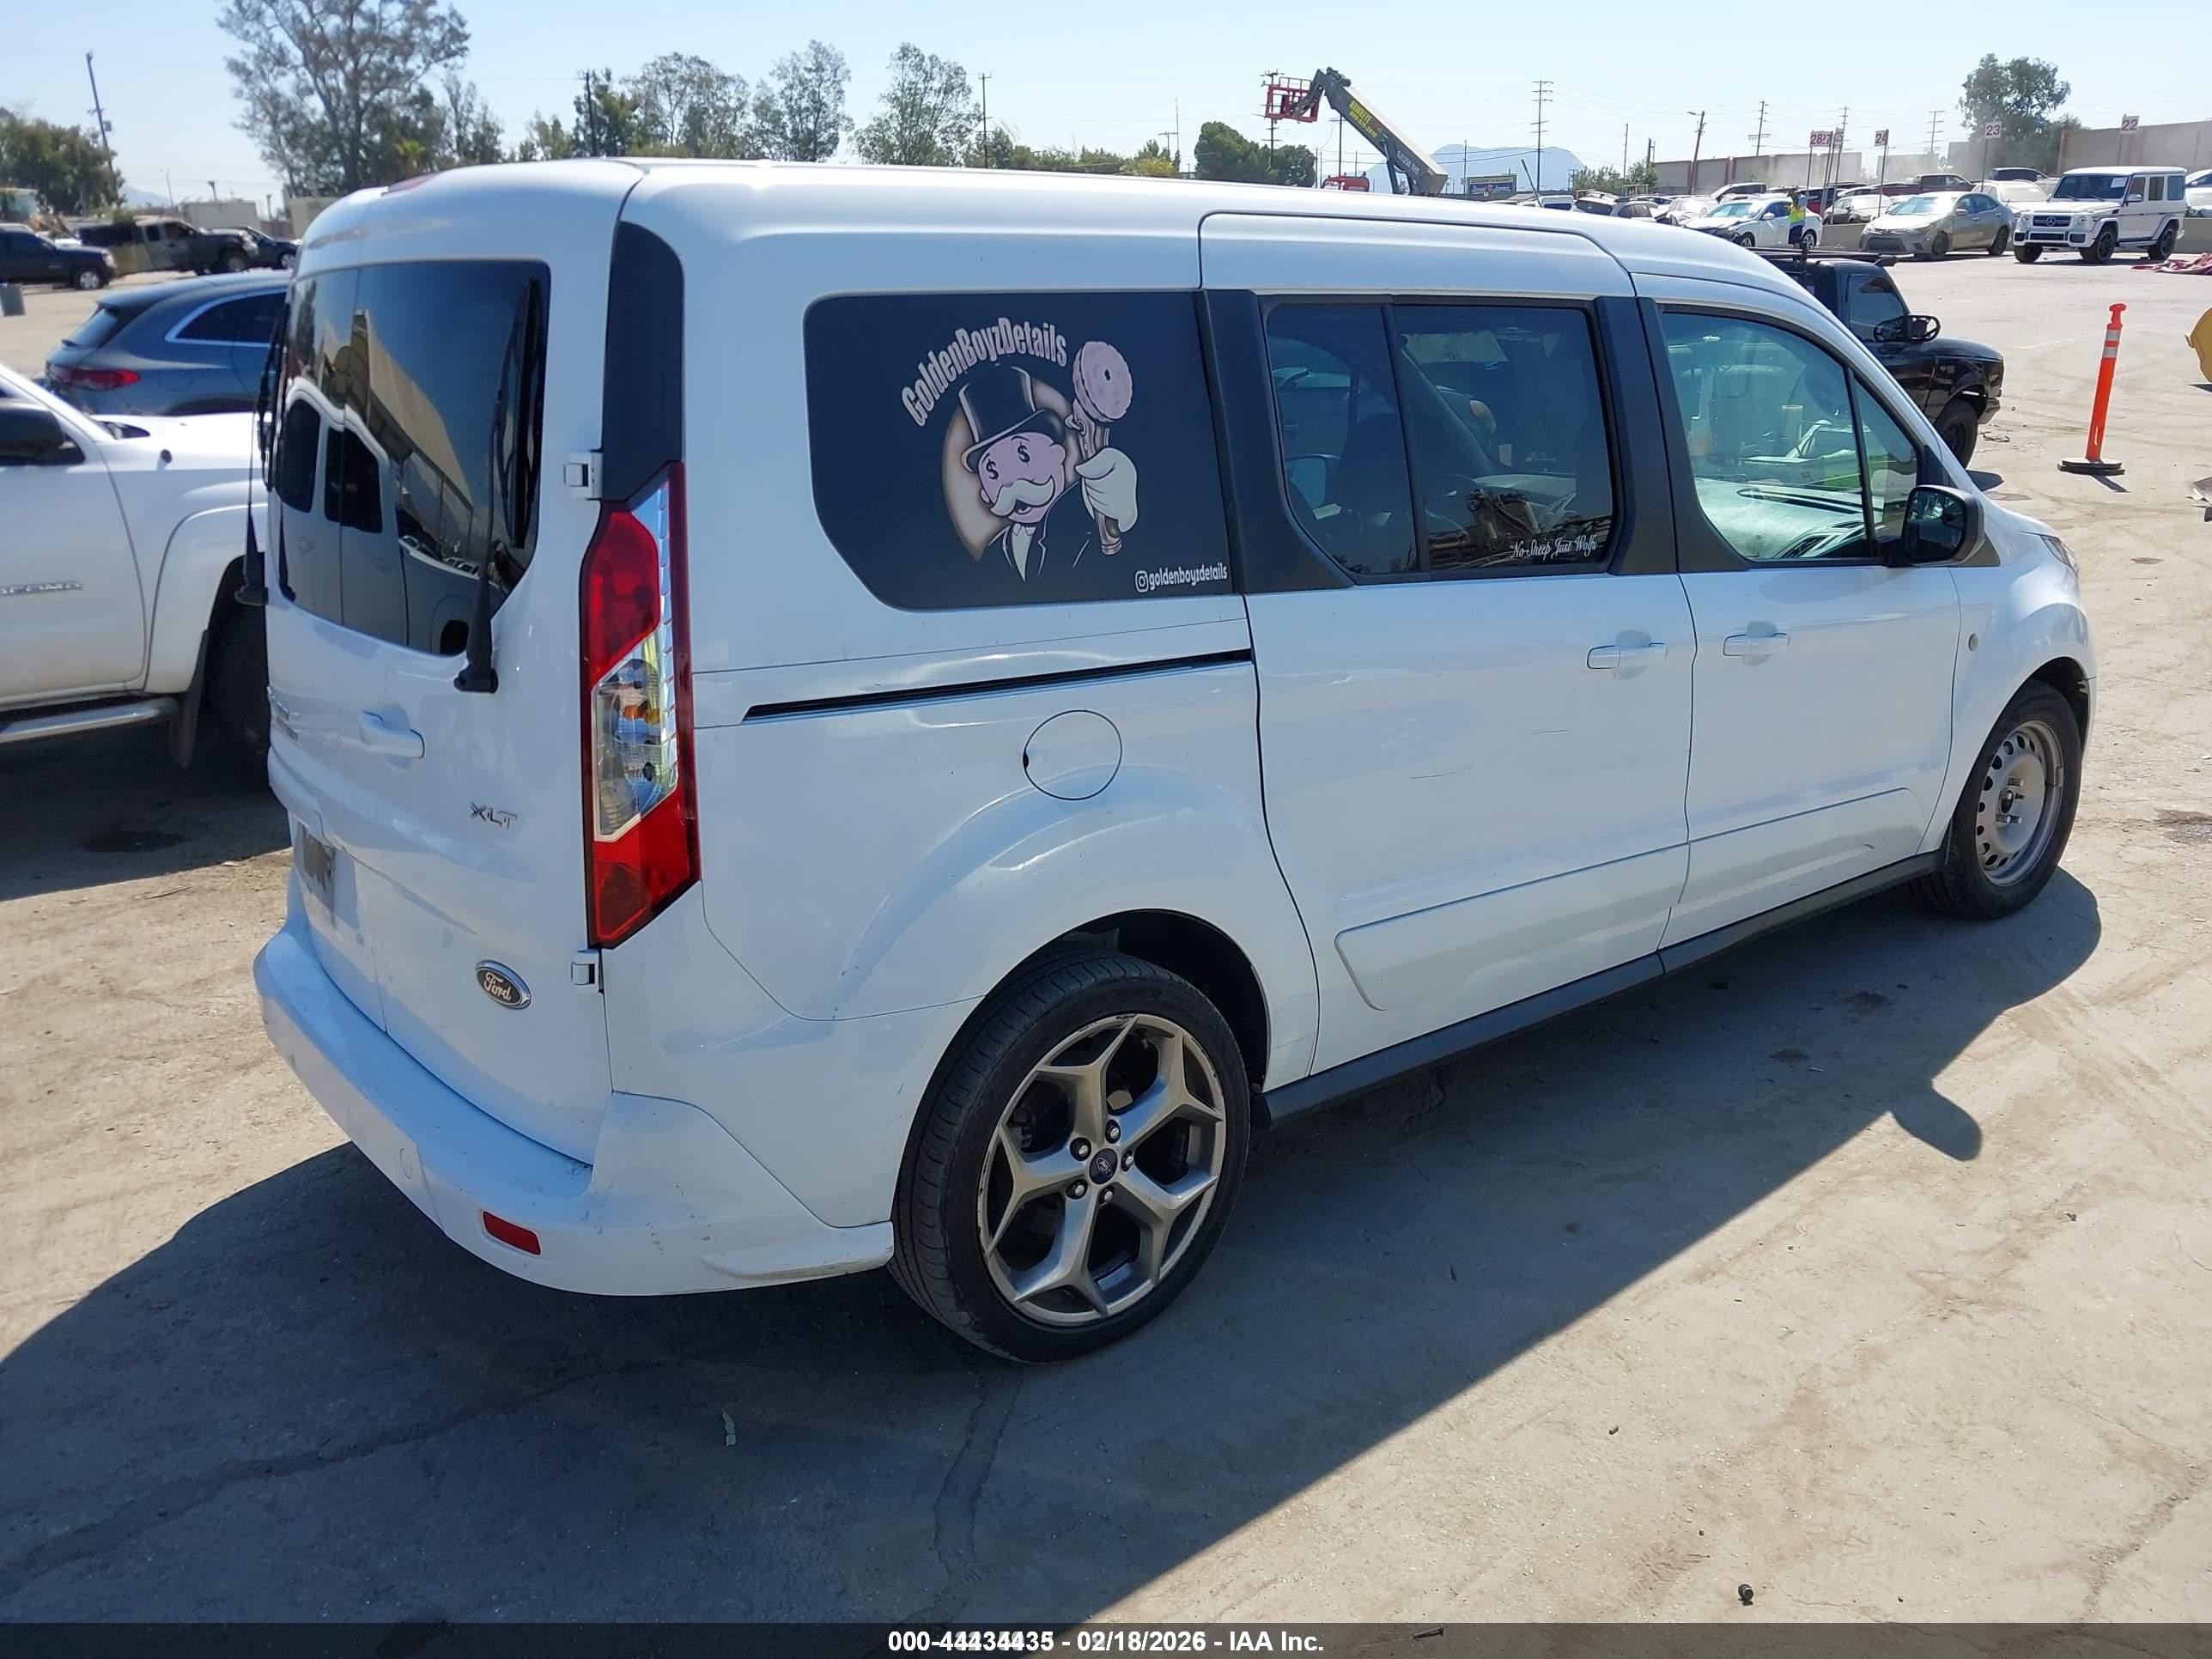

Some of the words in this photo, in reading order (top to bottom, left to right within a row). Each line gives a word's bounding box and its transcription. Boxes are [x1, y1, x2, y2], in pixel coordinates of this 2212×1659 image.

[1985, 125, 2001, 137] 23
[2121, 118, 2138, 131] 22
[901, 316, 1068, 428] GoldenBoyzDetails
[1510, 540, 1526, 558] No
[1526, 538, 1552, 562] Sheep
[1551, 536, 1574, 560] Just
[1573, 534, 1598, 557] Wolfs
[1149, 562, 1228, 591] goldenboyzdetails
[470, 800, 518, 829] XLT
[483, 971, 513, 1002] Ford
